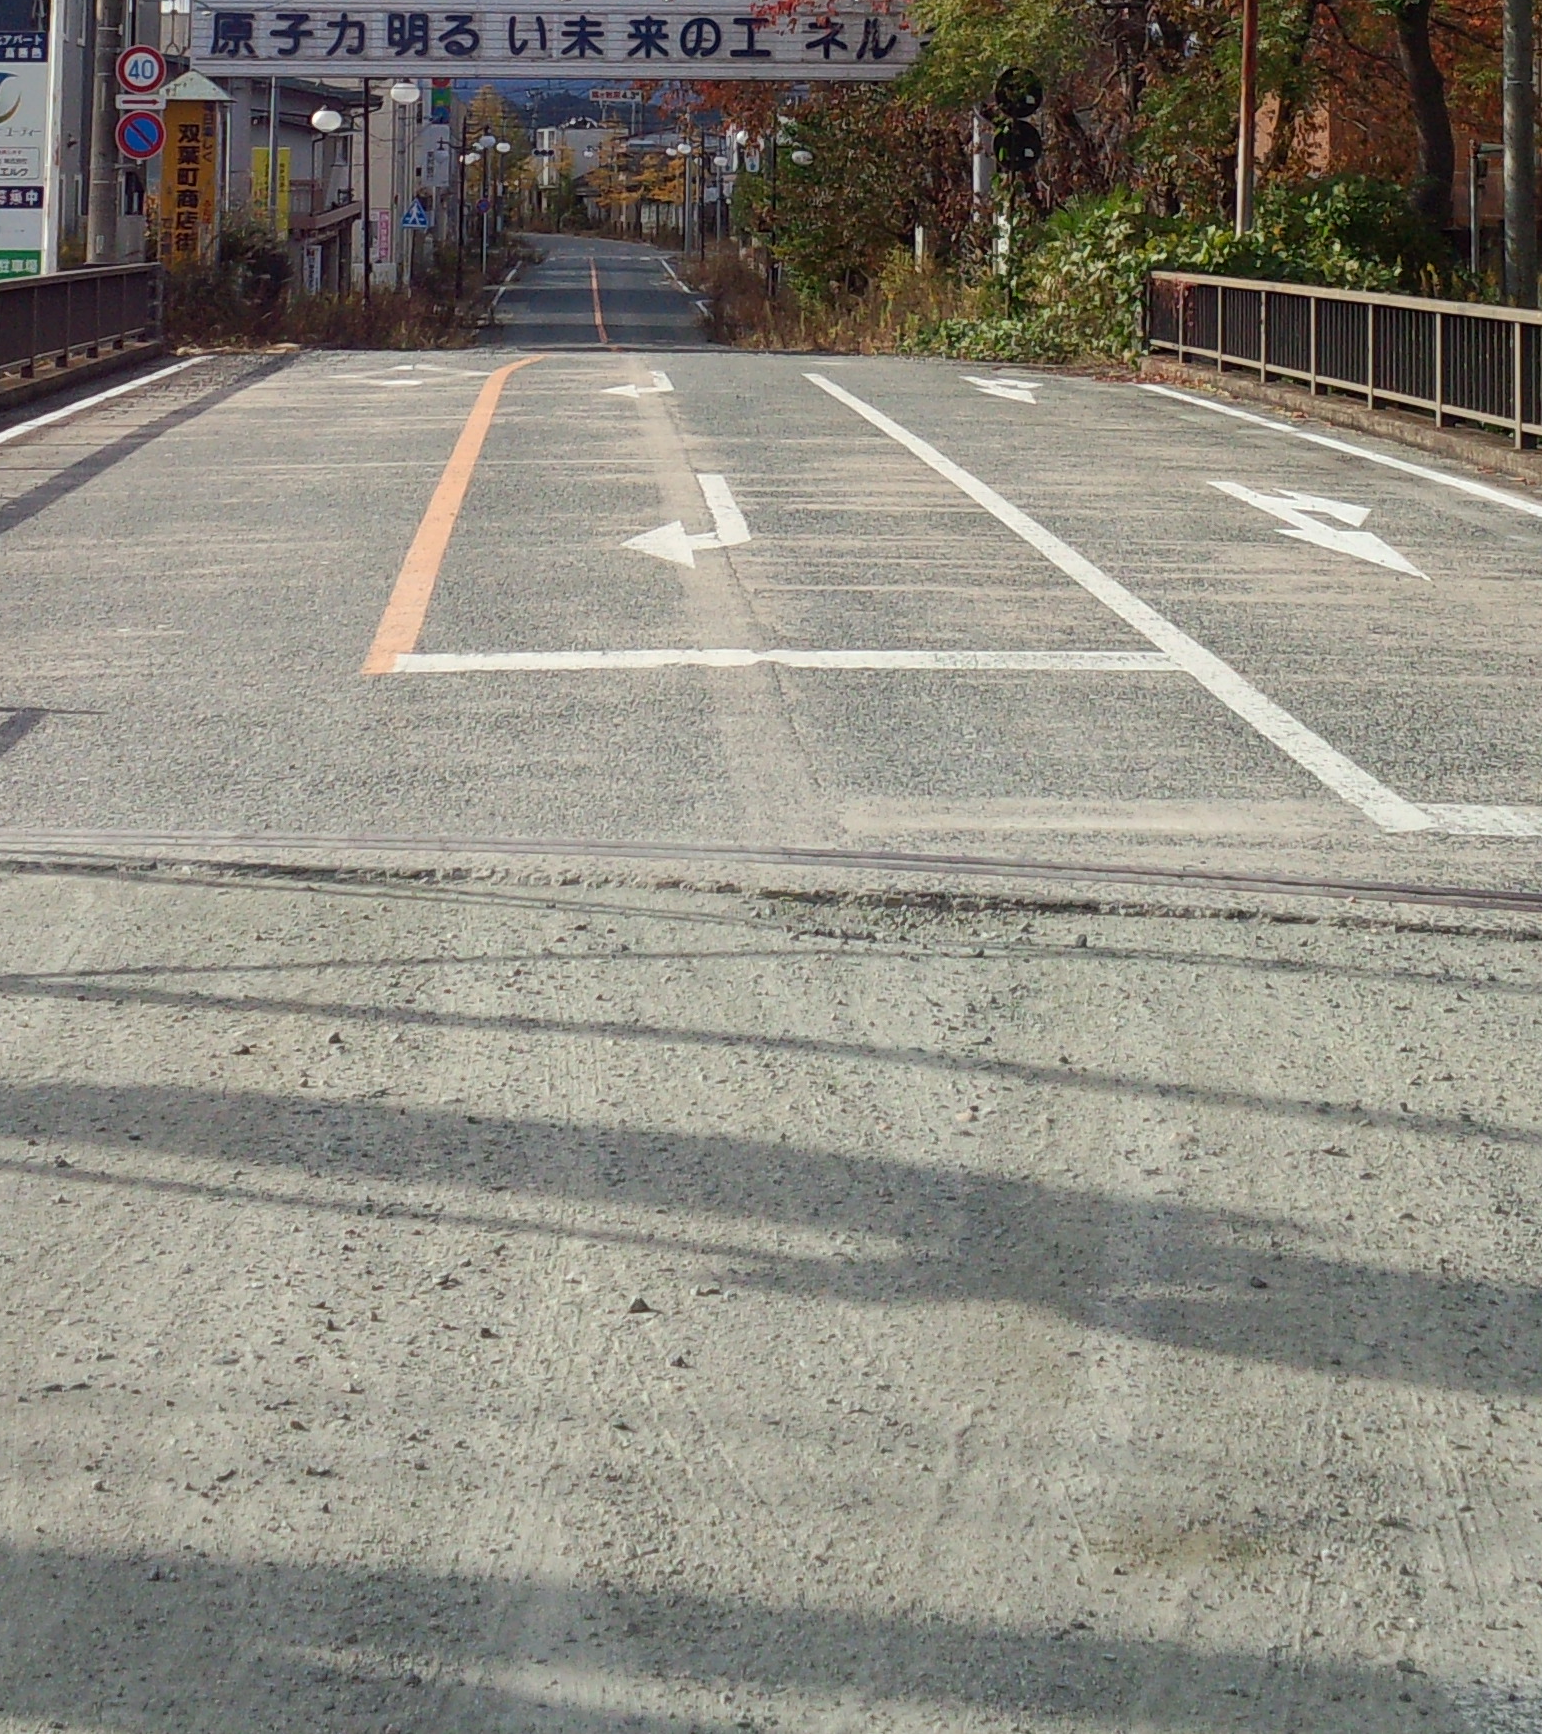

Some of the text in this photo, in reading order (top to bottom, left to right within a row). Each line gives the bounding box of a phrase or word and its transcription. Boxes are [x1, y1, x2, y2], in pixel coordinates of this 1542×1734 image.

[211, 12, 933, 58] 原子力明るい未来のエネル
[127, 59, 155, 80] 40
[176, 124, 200, 251] 双葉町商店街
